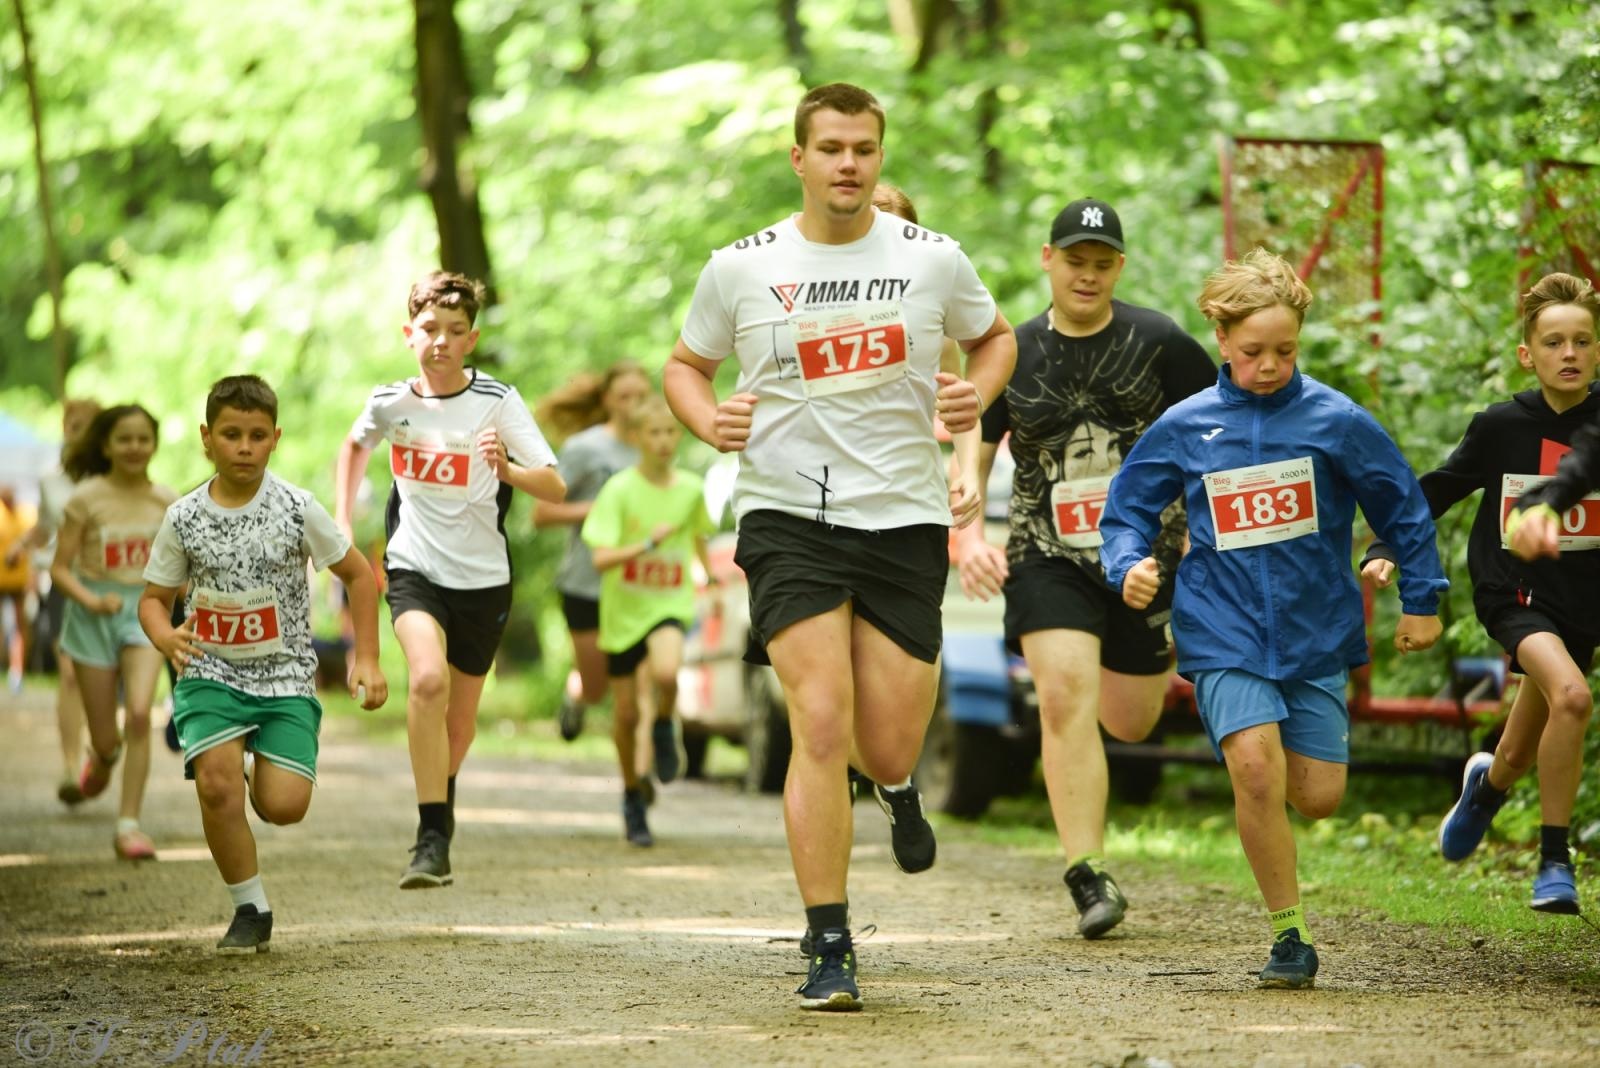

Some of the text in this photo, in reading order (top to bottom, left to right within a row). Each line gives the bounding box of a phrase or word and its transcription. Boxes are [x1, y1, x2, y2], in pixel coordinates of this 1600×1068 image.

[805, 279, 911, 304] MMA CITY
[870, 311, 890, 321] 4500
[817, 330, 890, 374] 175
[402, 450, 456, 483] 176
[1280, 469, 1300, 480] 4500
[1301, 468, 1309, 477] M
[1213, 477, 1231, 486] Bieg
[1230, 488, 1300, 529] 183
[208, 613, 264, 643] 178
